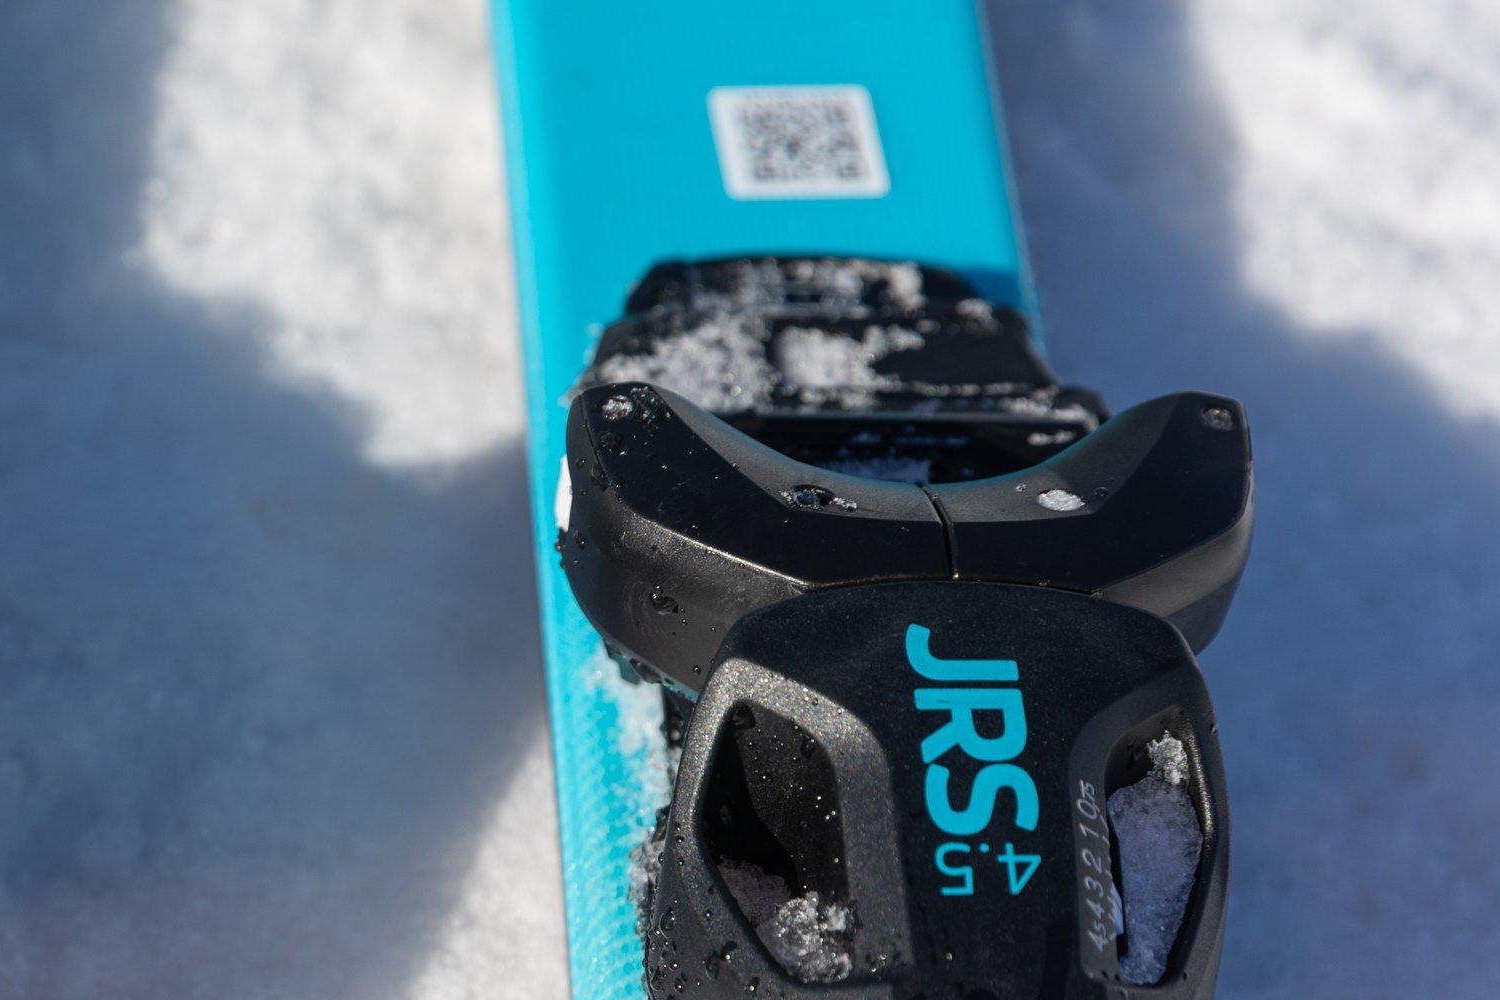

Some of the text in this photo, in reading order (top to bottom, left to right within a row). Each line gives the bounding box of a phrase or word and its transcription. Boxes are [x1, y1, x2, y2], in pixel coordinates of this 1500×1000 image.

[905, 622, 1040, 836] JRS
[935, 842, 1042, 896] 4.5
[1082, 848, 1103, 874] 2
[1083, 876, 1105, 898] 3
